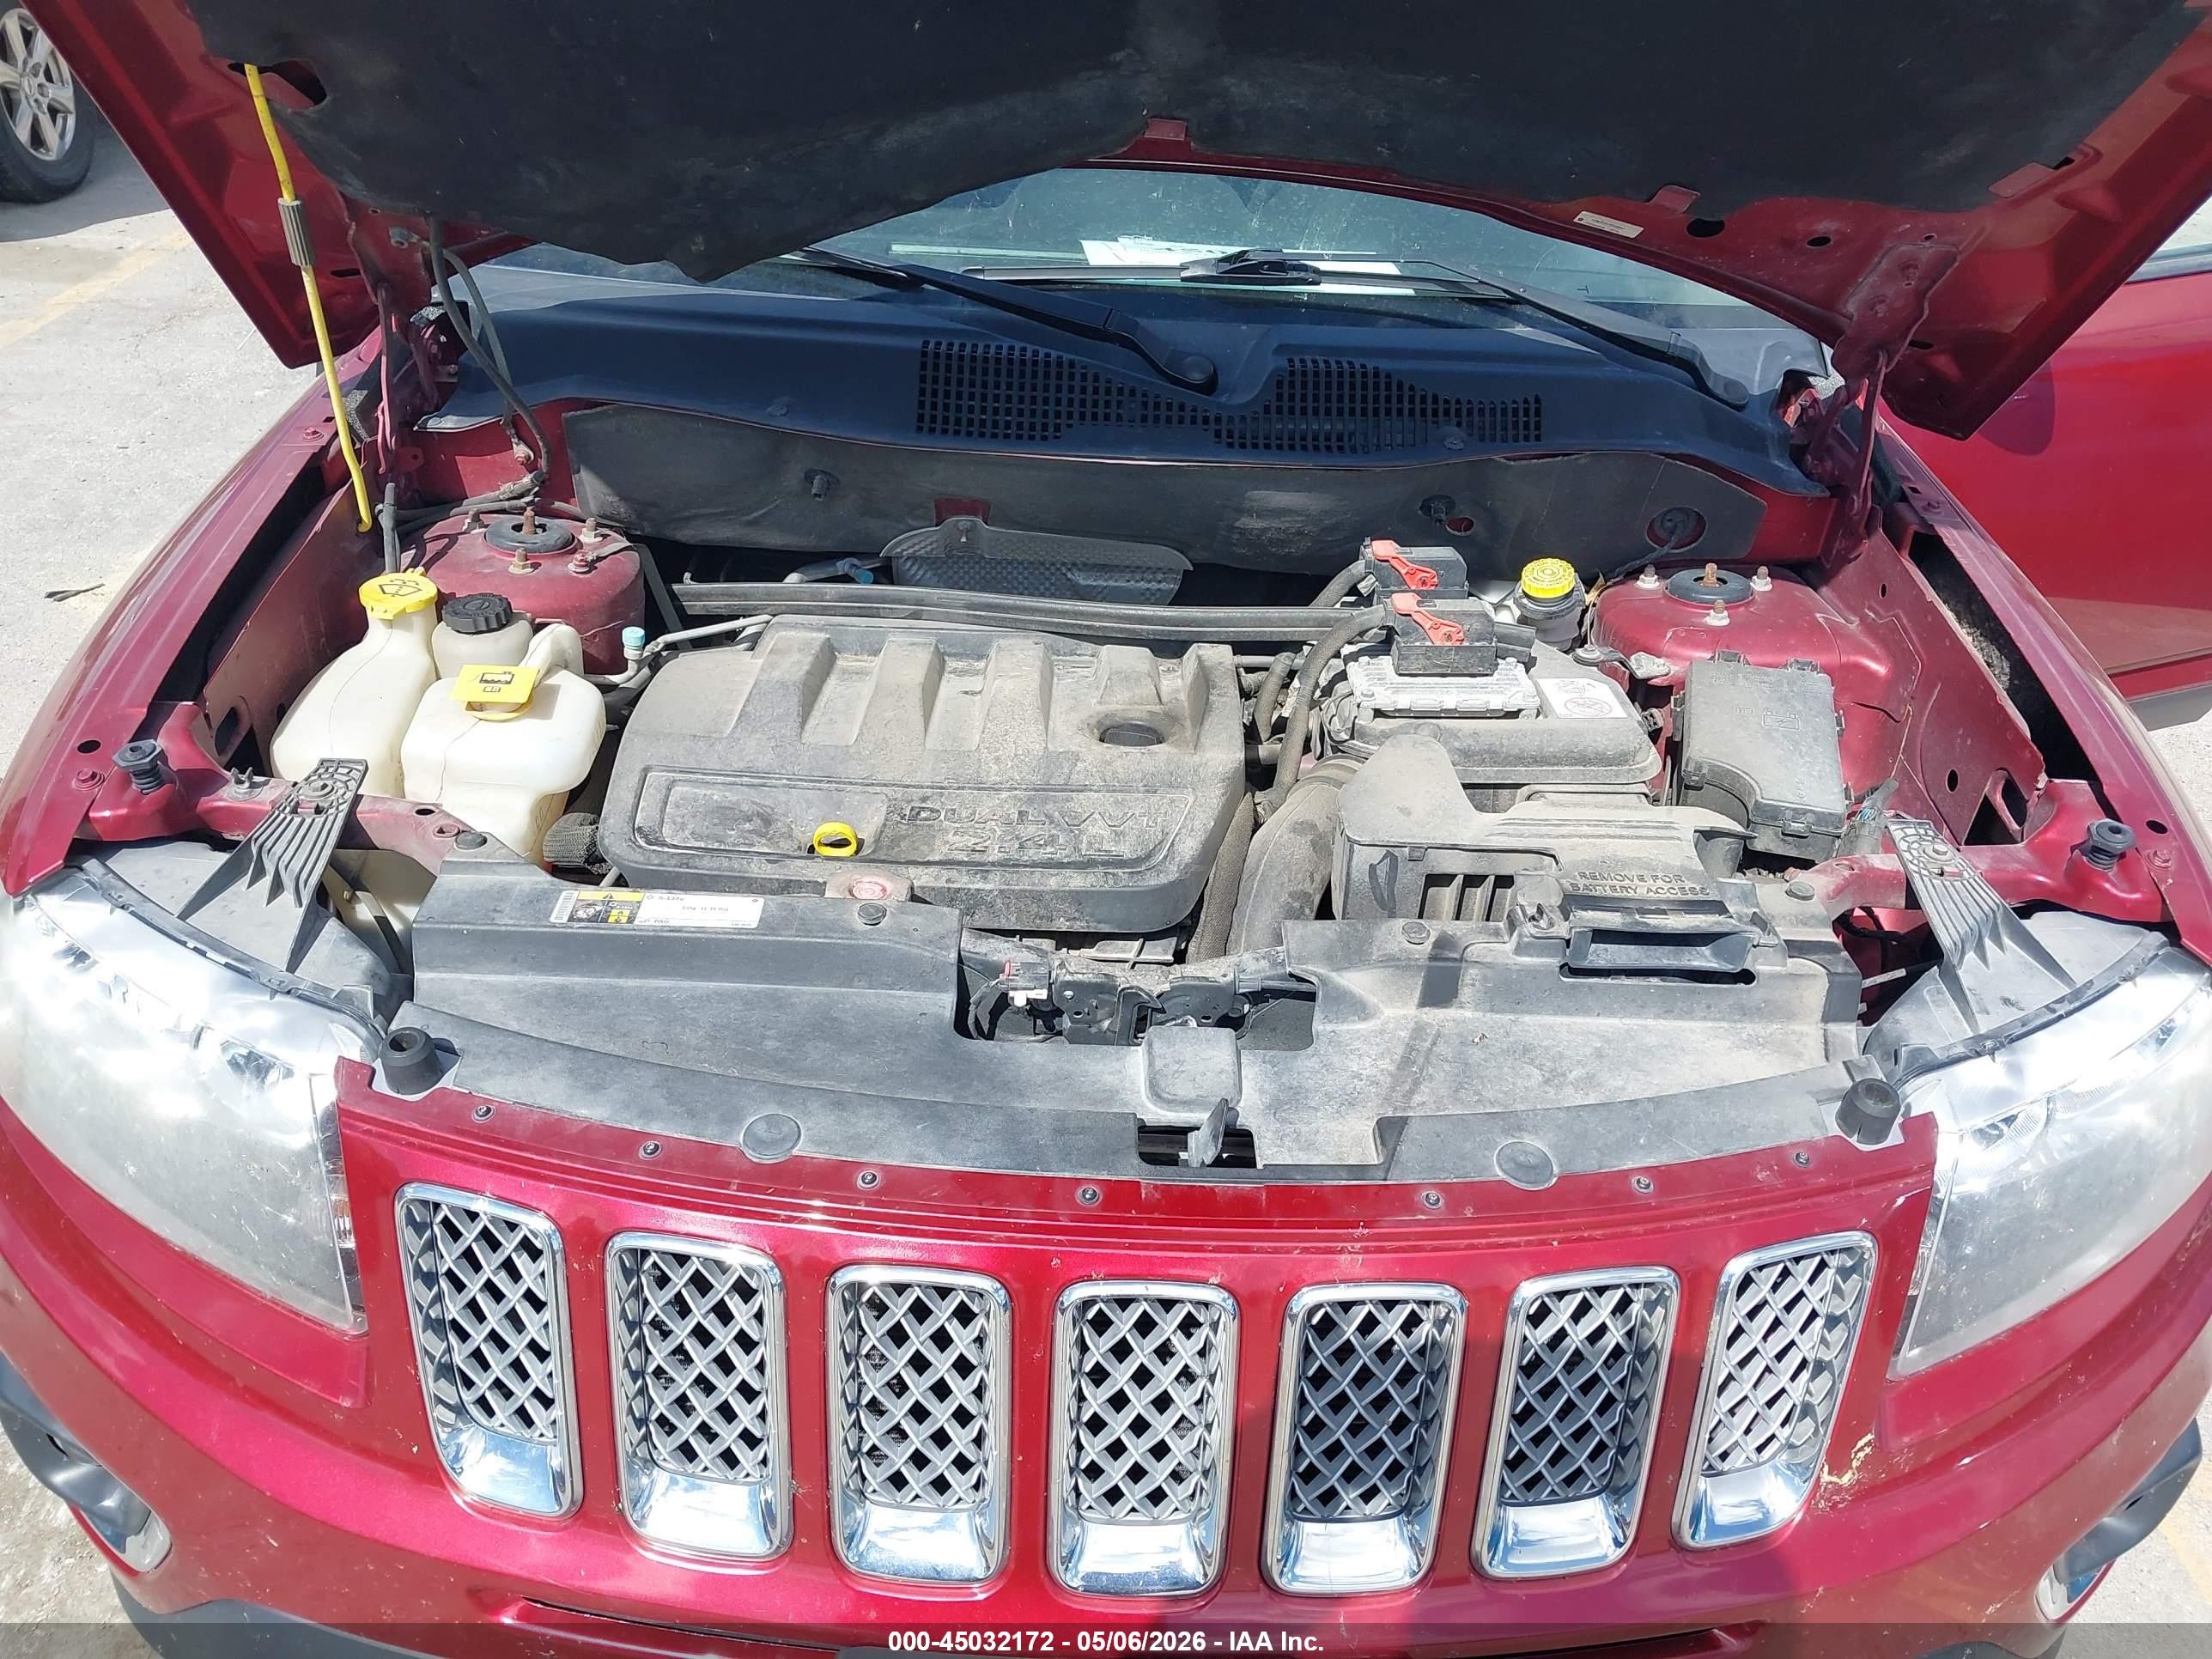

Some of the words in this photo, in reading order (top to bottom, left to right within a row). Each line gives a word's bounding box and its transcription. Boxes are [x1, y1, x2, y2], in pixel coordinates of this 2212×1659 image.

[906, 805, 1047, 826] DUAL
[1054, 811, 1169, 830] VVT
[1577, 872, 1646, 882] REMOVE
[1651, 874, 1685, 884] FOR
[1570, 883, 1638, 895] BATTERY
[1645, 886, 1710, 896] ACCESS
